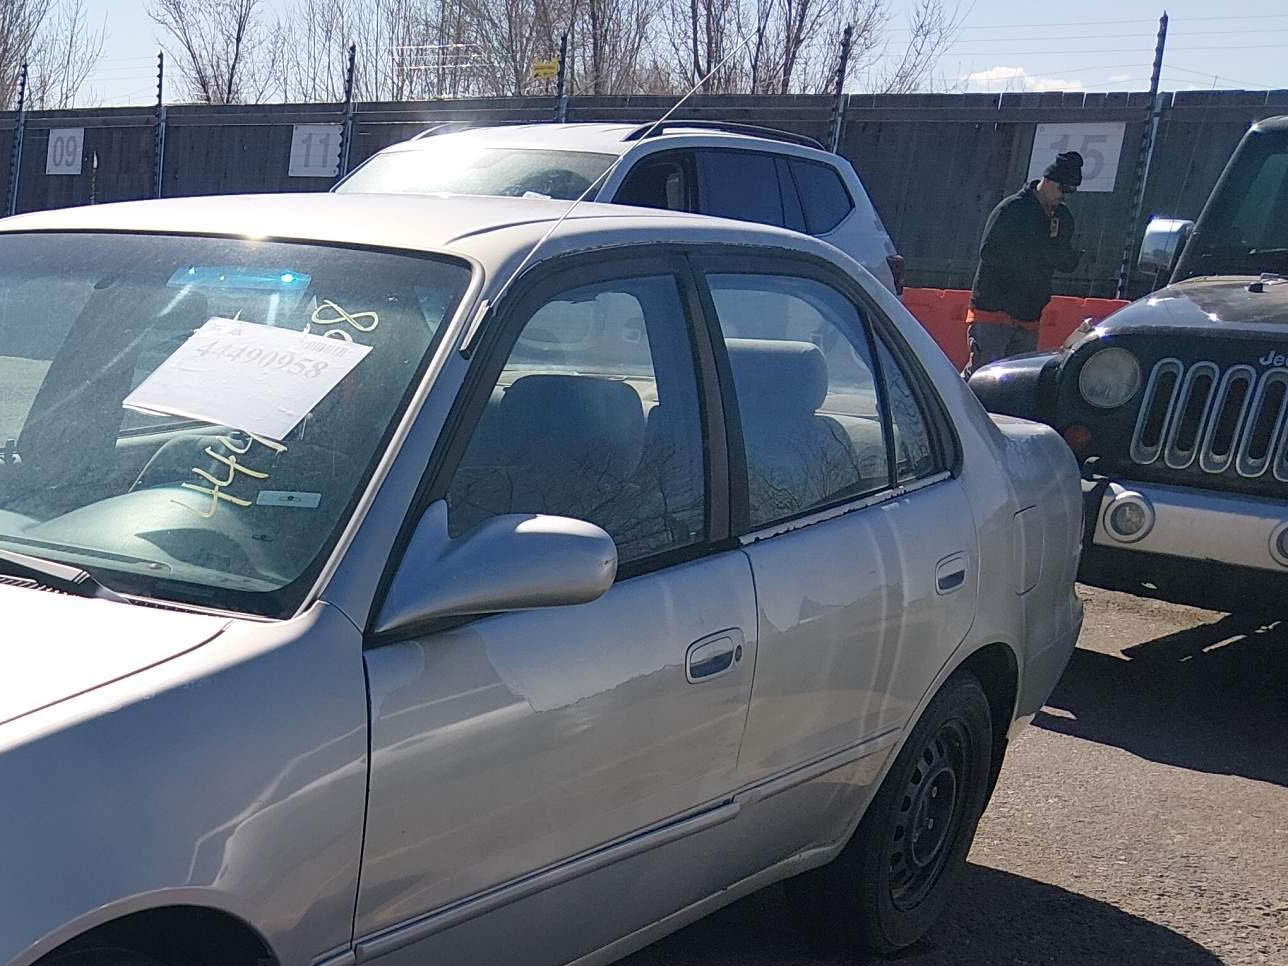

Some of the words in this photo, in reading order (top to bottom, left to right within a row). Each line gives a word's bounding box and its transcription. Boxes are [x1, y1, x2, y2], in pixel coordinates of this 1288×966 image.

[53, 135, 78, 168] 09
[301, 132, 331, 169] 11
[197, 339, 329, 379] 44490958
[1258, 350, 1288, 367] Je
